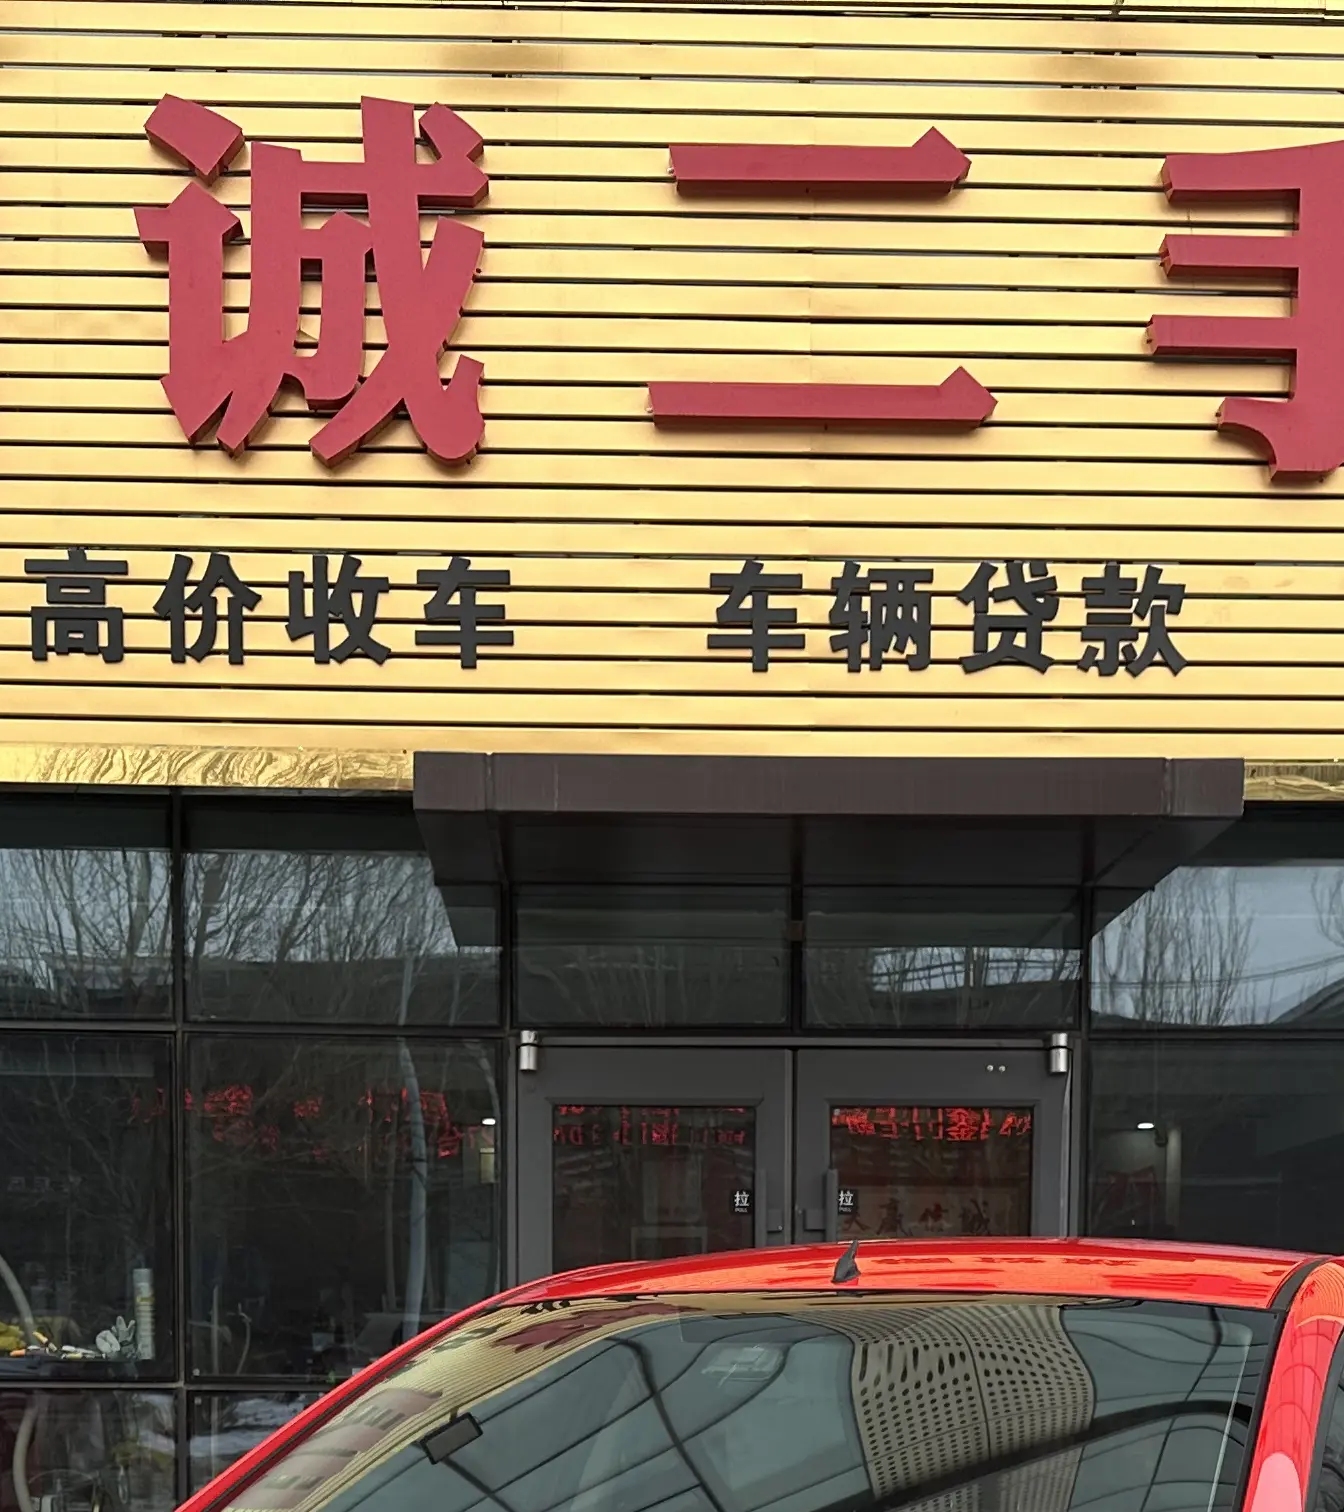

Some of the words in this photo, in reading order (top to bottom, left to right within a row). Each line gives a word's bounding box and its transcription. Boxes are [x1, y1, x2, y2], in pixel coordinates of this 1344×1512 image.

[23, 549, 514, 669] 高价收车
[707, 561, 1186, 677] 车辆贷款
[734, 1190, 750, 1207] 拉
[838, 1190, 854, 1206] 拉
